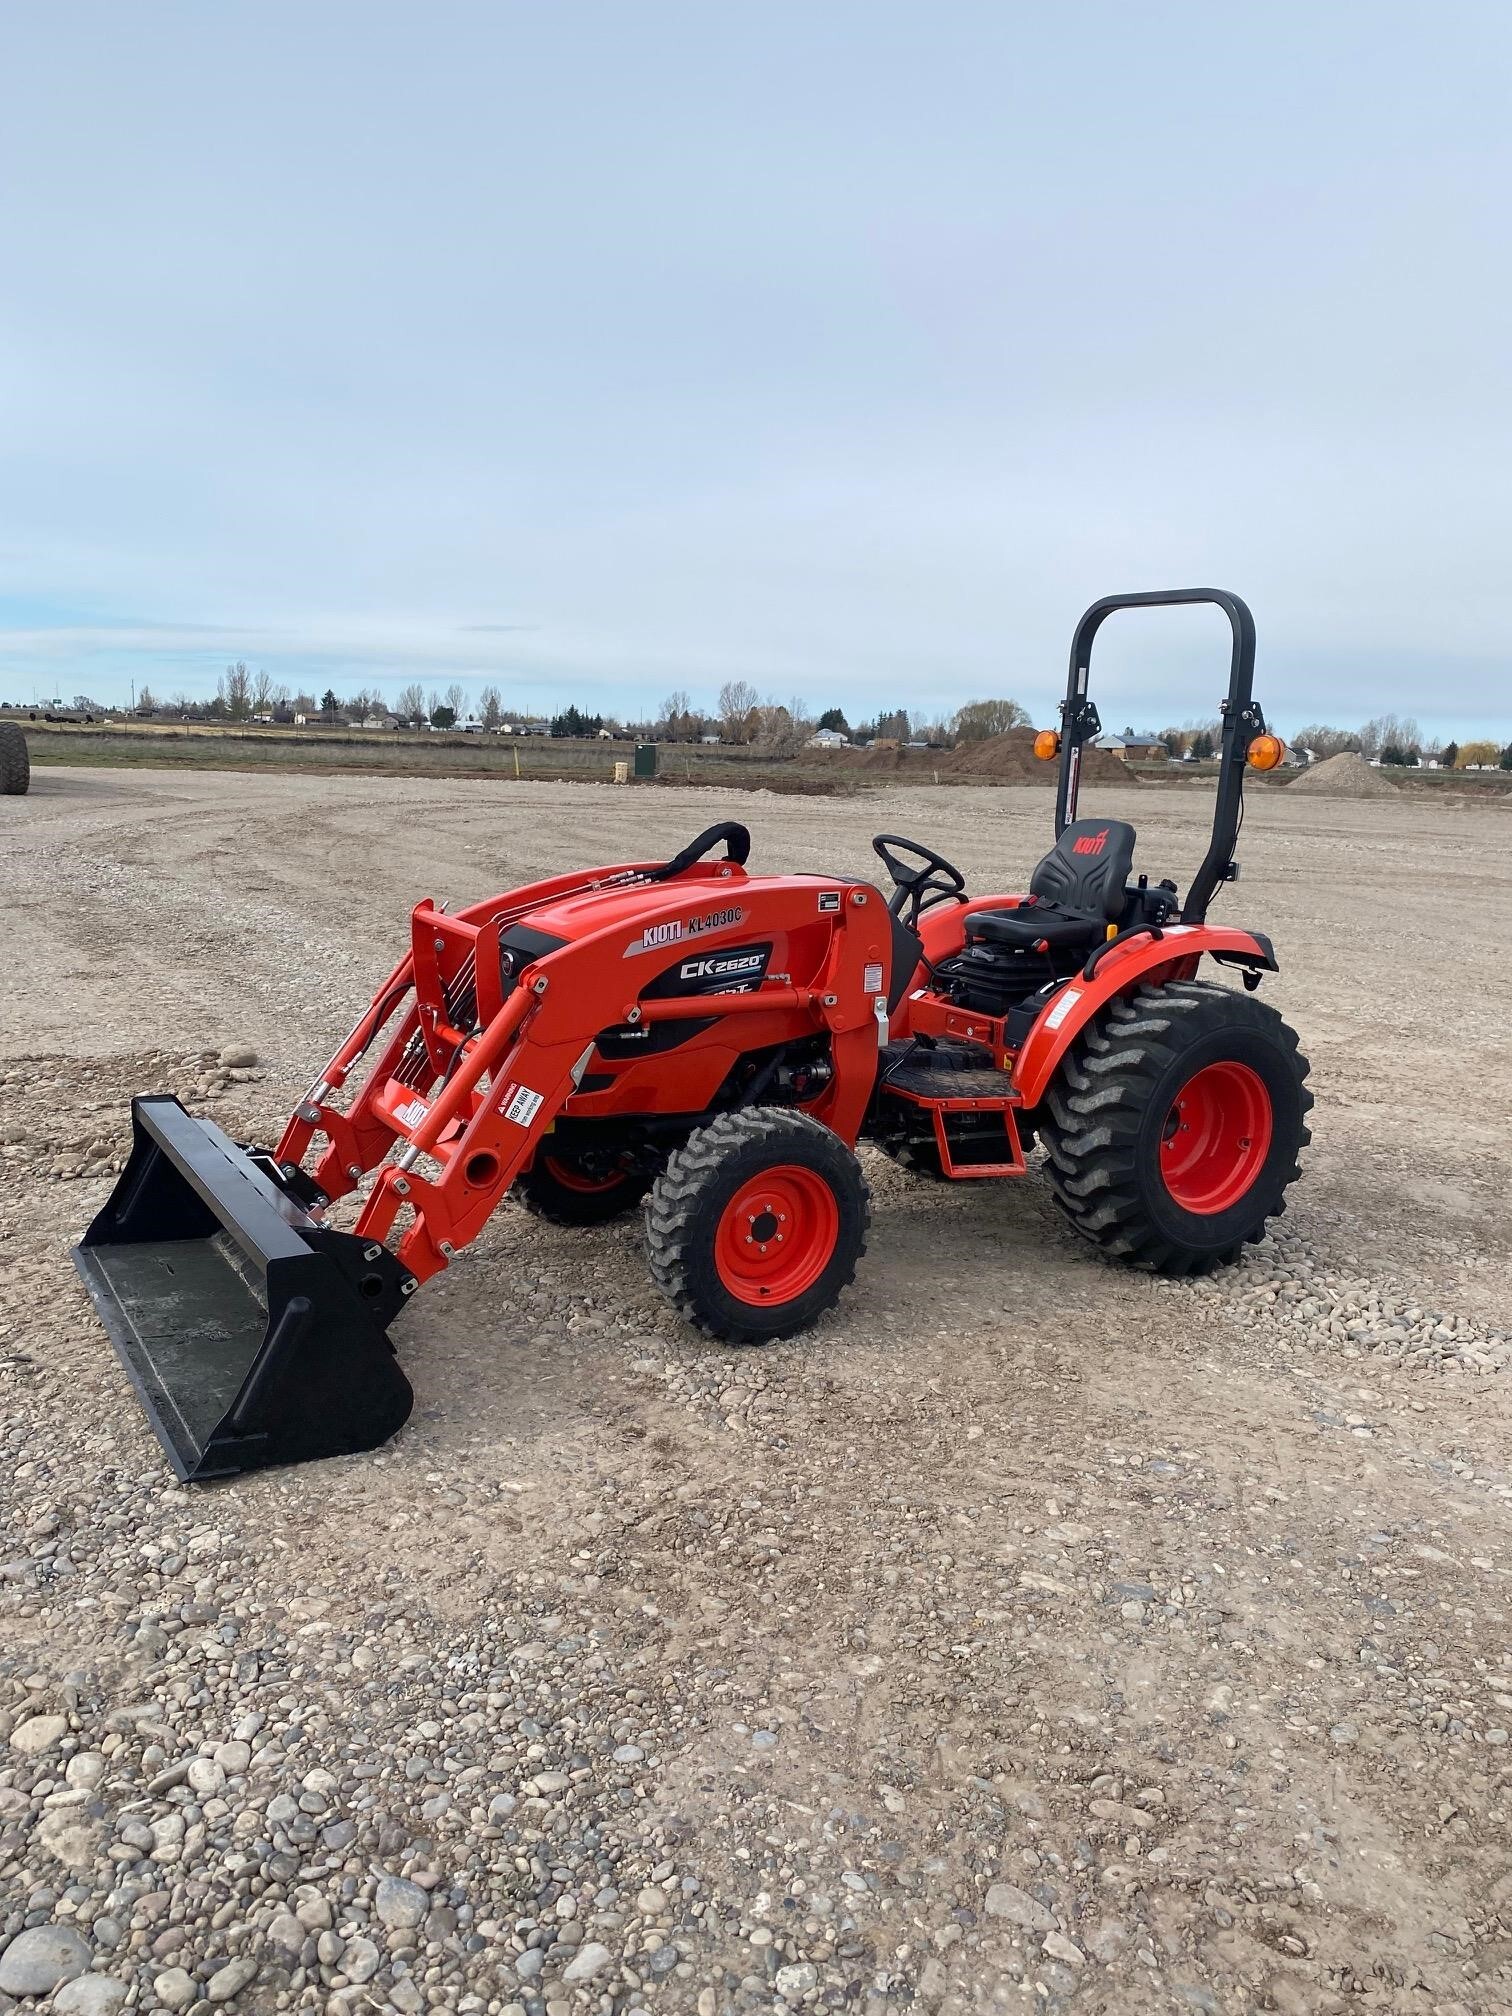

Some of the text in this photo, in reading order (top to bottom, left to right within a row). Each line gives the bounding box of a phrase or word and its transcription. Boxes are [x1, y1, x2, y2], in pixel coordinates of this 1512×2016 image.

[643, 906, 742, 948] KIOTI KL4030C
[509, 1089, 530, 1120] KEEP AWAY
